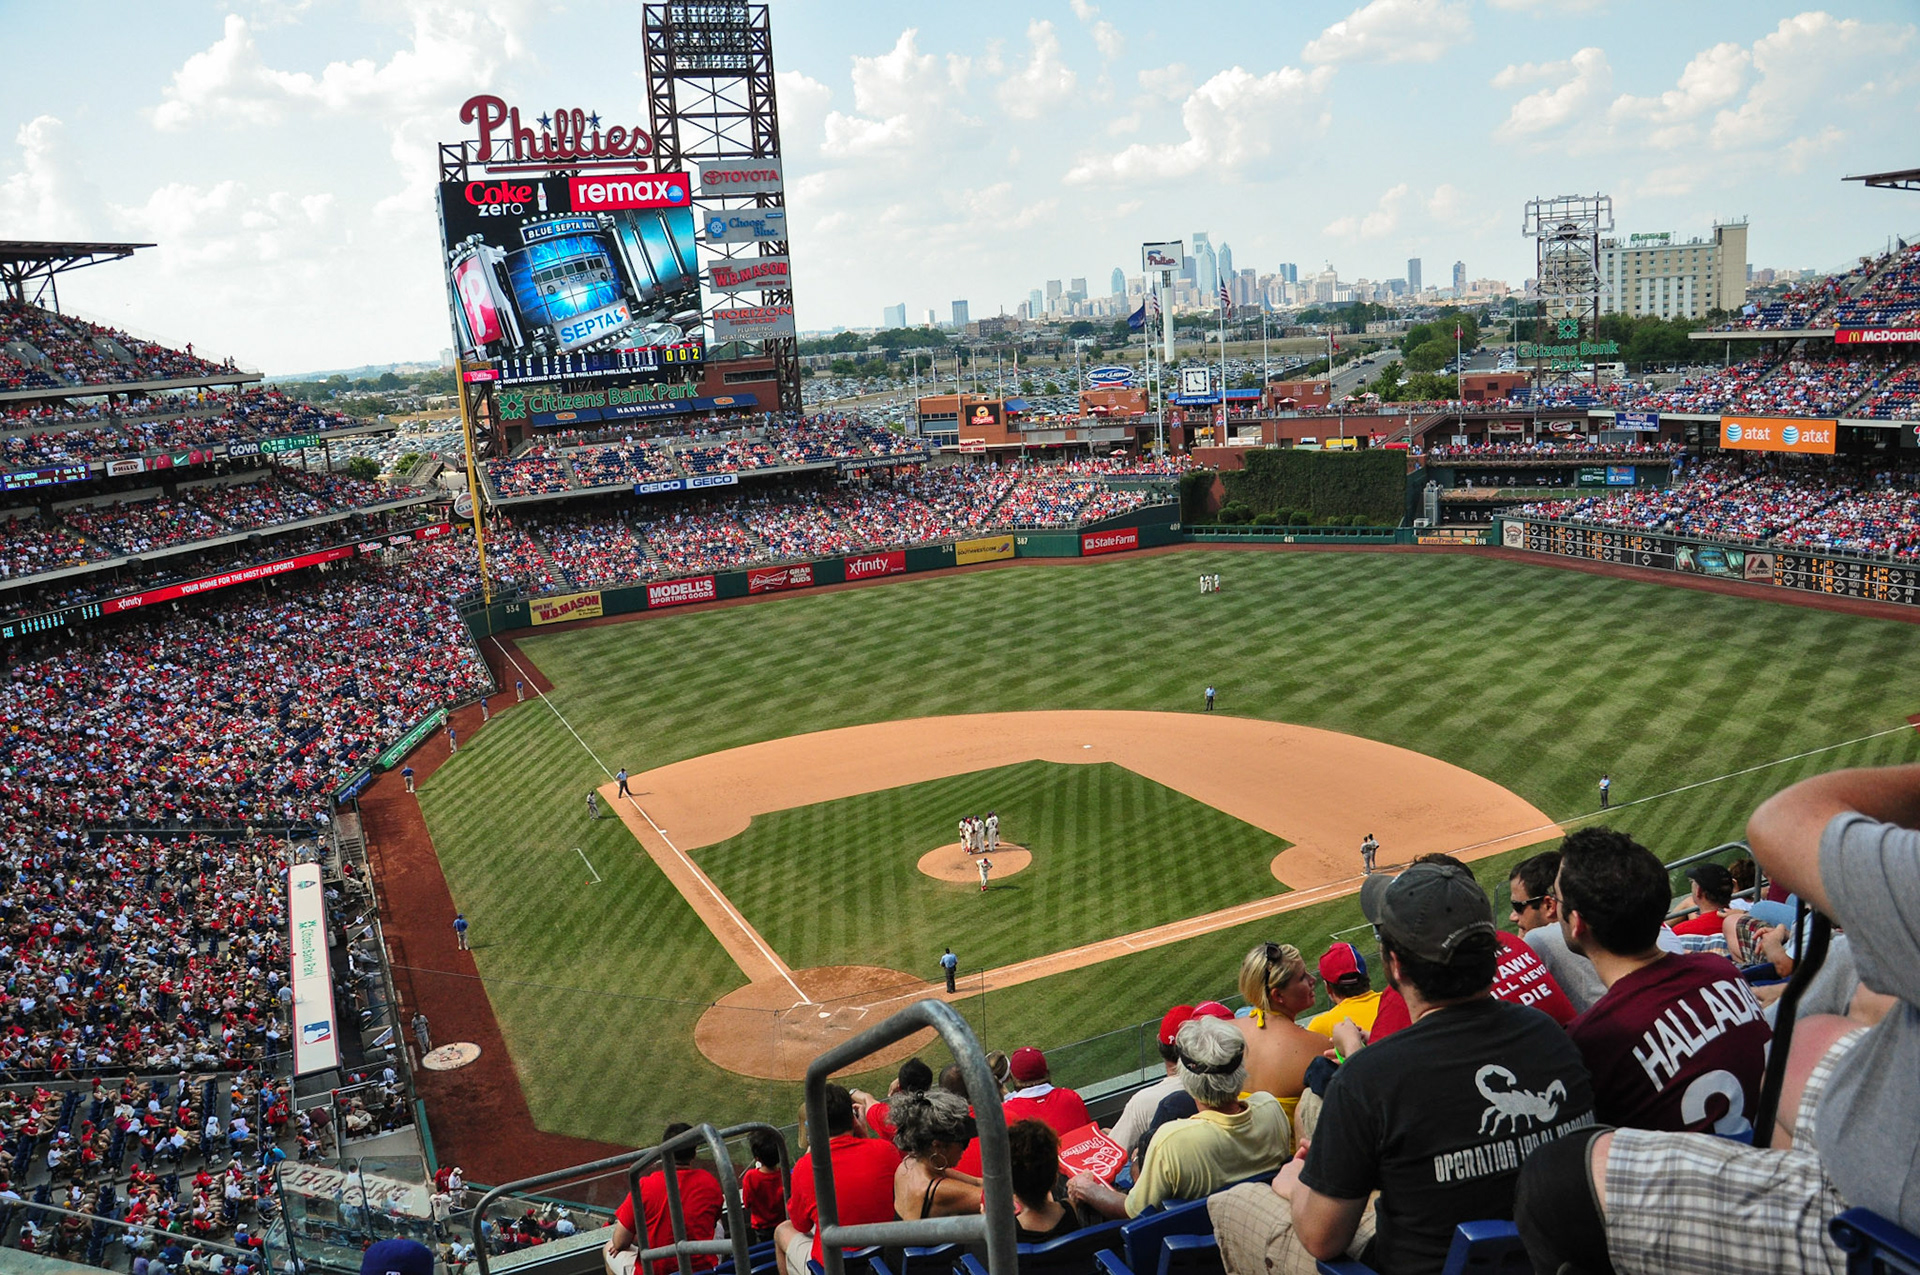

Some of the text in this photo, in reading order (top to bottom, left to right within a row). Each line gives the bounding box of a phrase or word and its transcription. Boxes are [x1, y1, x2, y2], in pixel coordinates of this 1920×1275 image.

[460, 94, 654, 162] Phillies
[722, 170, 779, 182] TOYOTA
[464, 181, 532, 206] Coke
[578, 180, 669, 203] remax
[478, 203, 523, 216] zero
[528, 221, 596, 238] BLUE SEPTA BUS
[729, 218, 765, 228] Choose
[754, 226, 778, 236] Blue.
[714, 306, 792, 320] HORIZON
[560, 314, 614, 344] SEPTA
[730, 318, 776, 326] SERVICES
[666, 348, 699, 362] 0 0 2
[1518, 340, 1619, 357] Citizens Bank
[1551, 357, 1584, 371] Park
[576, 370, 602, 378] PHILLIES
[603, 368, 632, 376] PHILLIES,
[529, 380, 698, 414] Citizens Bank Park
[616, 405, 648, 414] HARRY
[1744, 427, 1830, 444] at&t at&t
[230, 443, 258, 456] GOYA
[841, 454, 928, 471] Jefferson University Hospitals
[640, 475, 732, 492] GEICO GEICO
[1016, 537, 1028, 545] 387
[850, 558, 888, 575] xfinity
[181, 561, 294, 594] YOUR HOME FOR THE MOST LIVE SPORTS
[752, 574, 787, 586] Budweiser
[790, 576, 812, 584] BUDS
[650, 580, 713, 599] MODELL'S
[651, 590, 714, 605] SPORTING GOODS
[118, 596, 142, 610] xfinity
[505, 604, 520, 614] 334
[1493, 952, 1536, 983] AWK
[1490, 982, 1520, 1000] ILL
[1519, 983, 1552, 1006] DIE
[1632, 978, 1767, 1092] HALLADA
[1434, 1140, 1518, 1182] OPERATION
